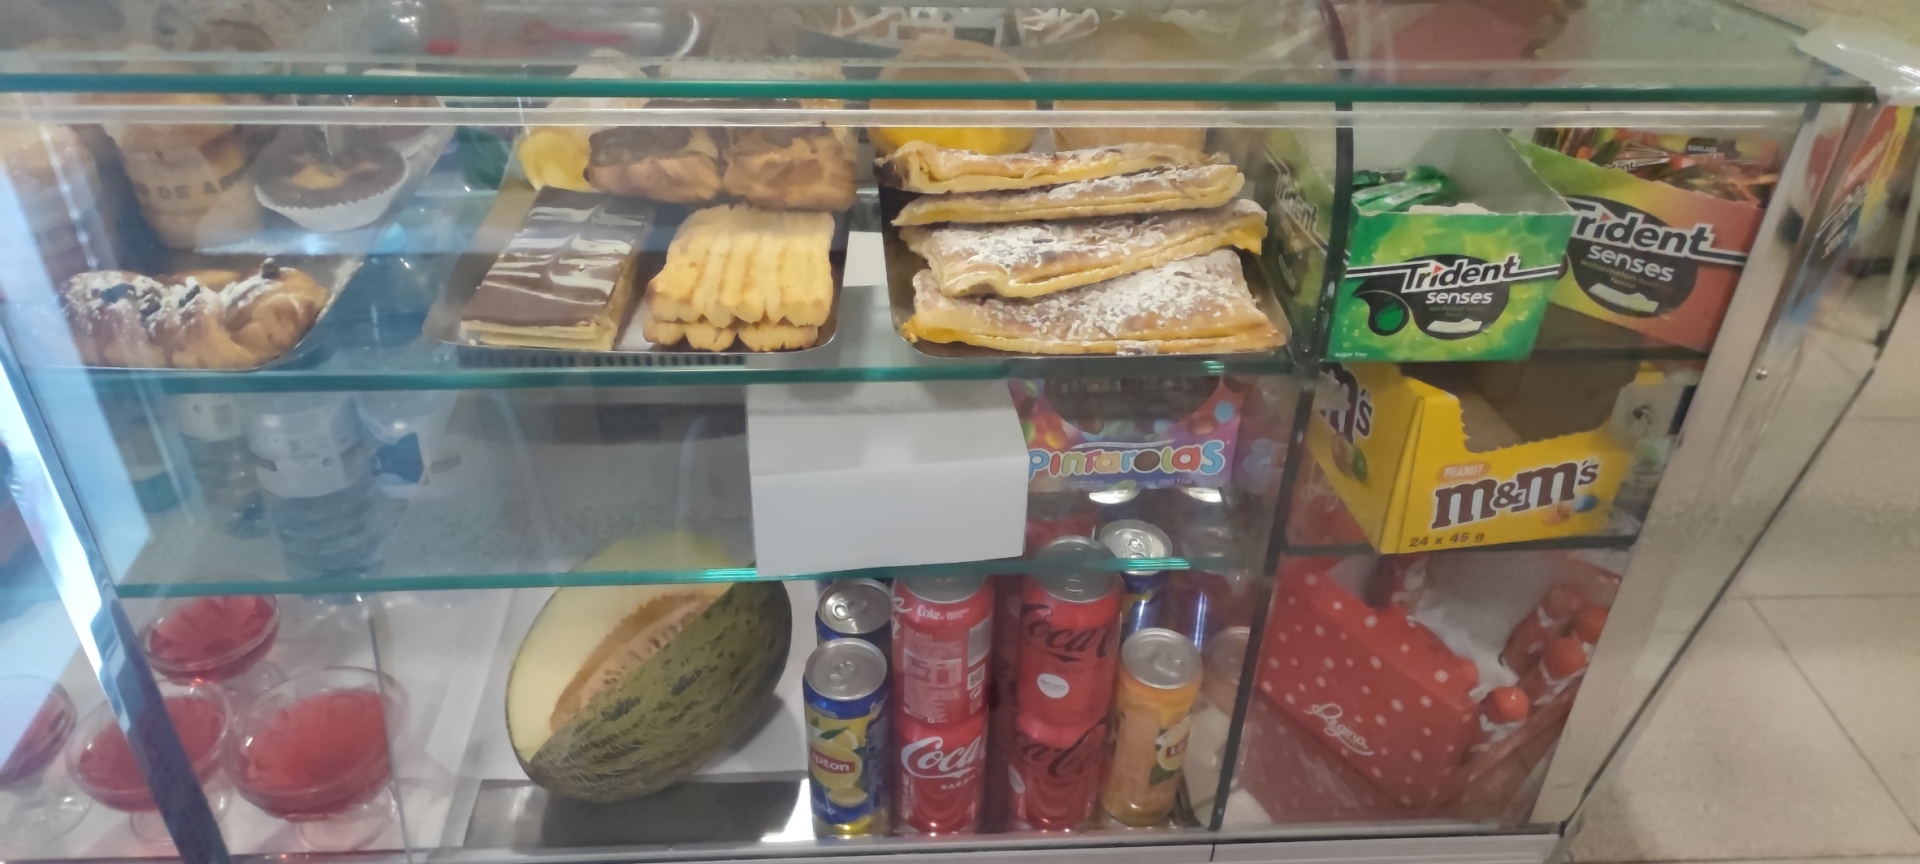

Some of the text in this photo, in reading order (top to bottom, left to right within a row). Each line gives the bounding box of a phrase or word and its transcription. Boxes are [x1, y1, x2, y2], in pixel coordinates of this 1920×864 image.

[1579, 258, 1637, 282] watermelon
[1587, 244, 1676, 283] senses
[1401, 254, 1520, 292] Trident
[1425, 291, 1494, 305] senses
[1443, 464, 1485, 479] PEANUT
[1408, 532, 1486, 548] 24 x 45 g
[916, 604, 942, 620] Coke
